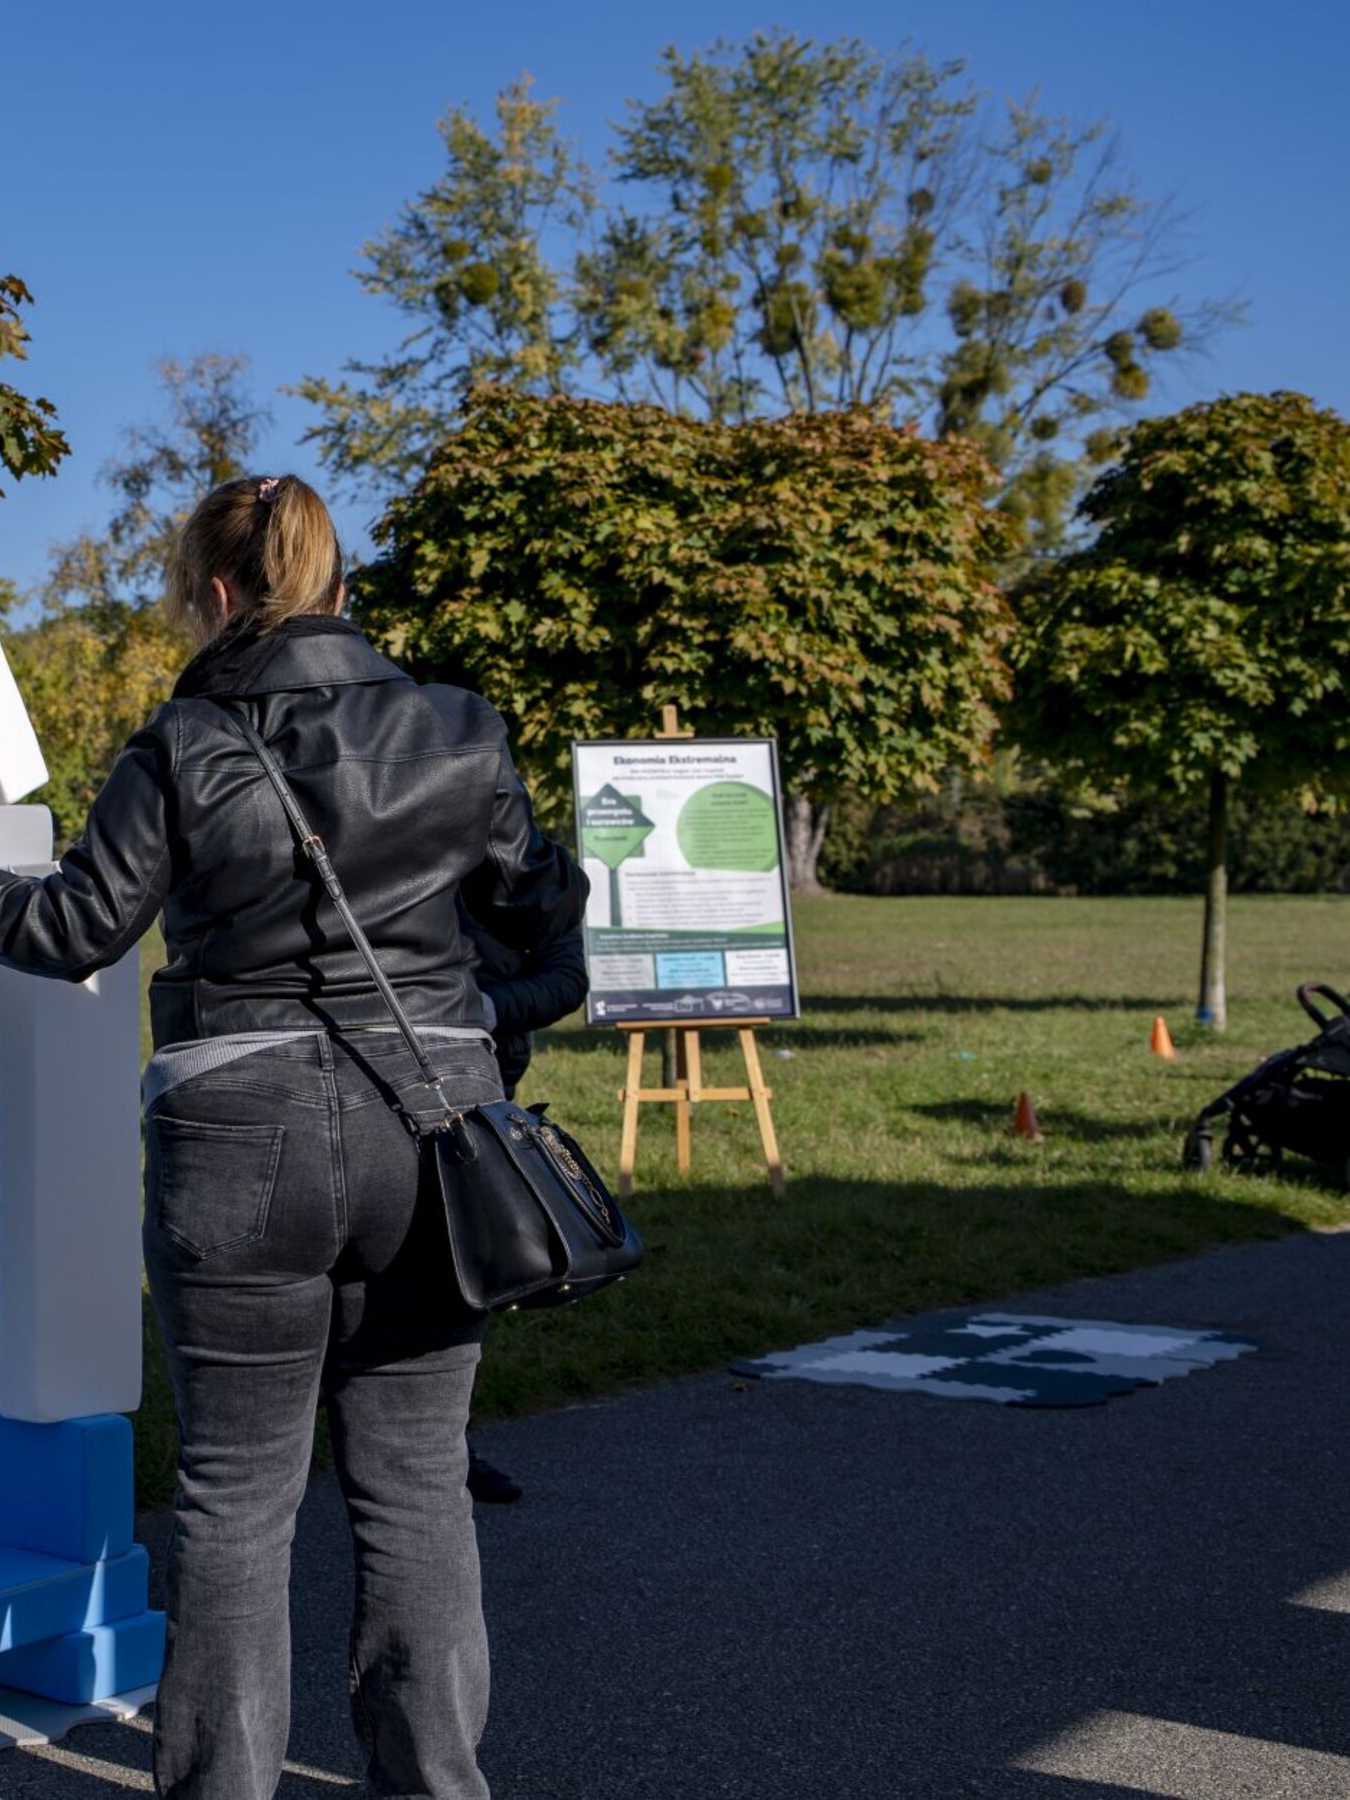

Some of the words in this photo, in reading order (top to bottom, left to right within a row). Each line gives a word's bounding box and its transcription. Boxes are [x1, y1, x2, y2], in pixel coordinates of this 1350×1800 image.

[613, 755, 666, 765] Ekonomia
[669, 754, 737, 764] Ekstremalna
[601, 798, 617, 806] Era
